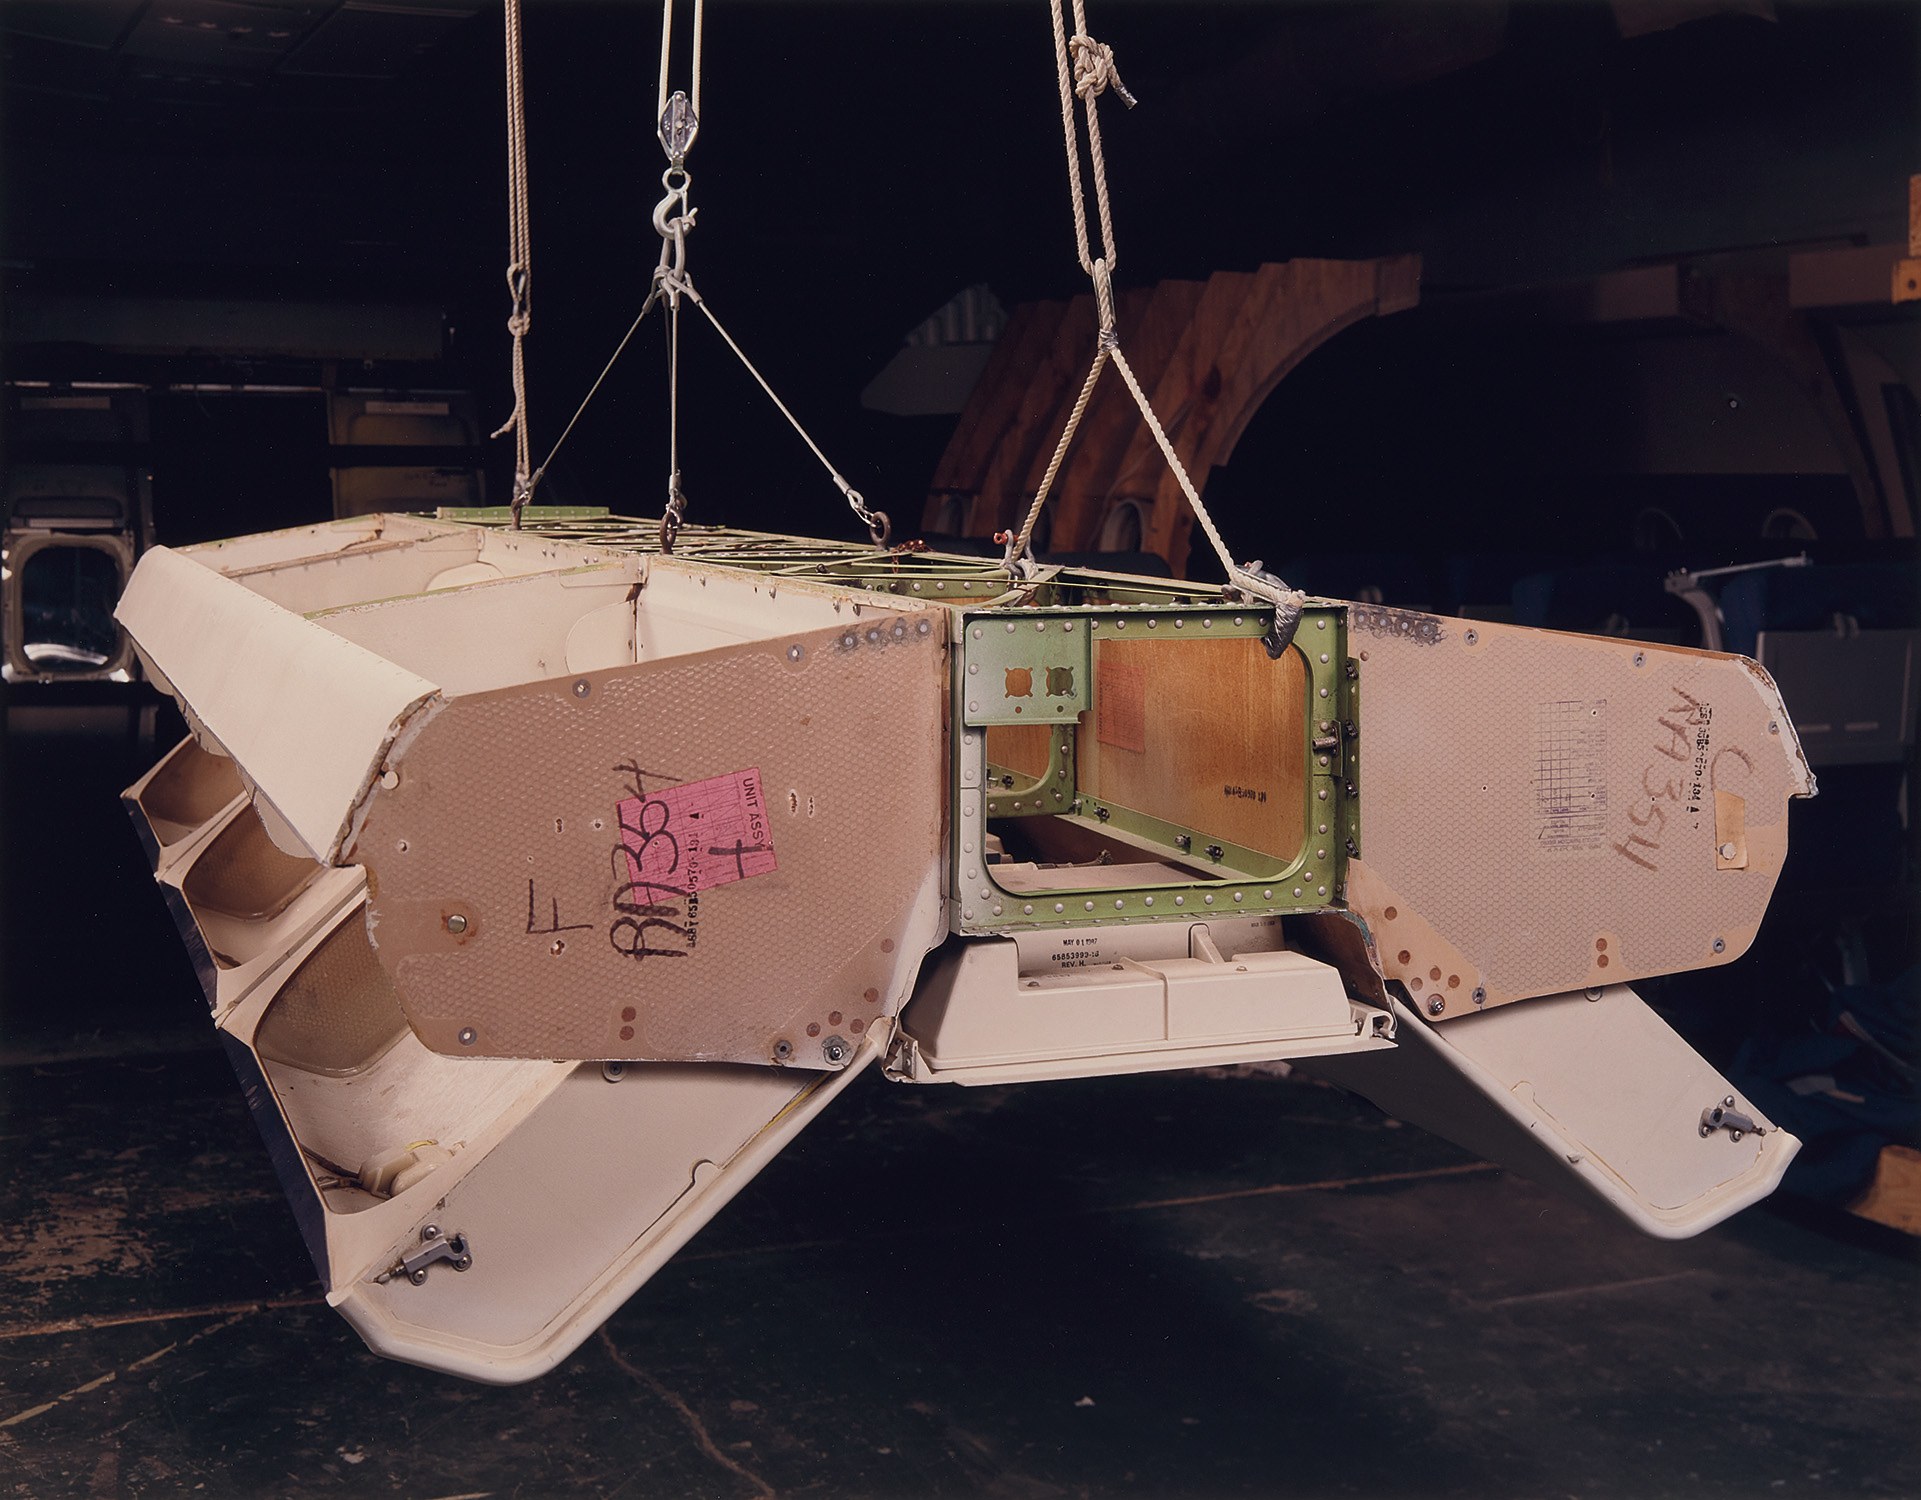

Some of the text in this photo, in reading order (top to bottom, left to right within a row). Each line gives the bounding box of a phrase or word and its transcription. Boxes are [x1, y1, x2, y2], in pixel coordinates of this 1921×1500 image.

[742, 777, 767, 850] UNIT ASSY
[525, 878, 593, 934] F
[1063, 939, 1074, 947] MAY
